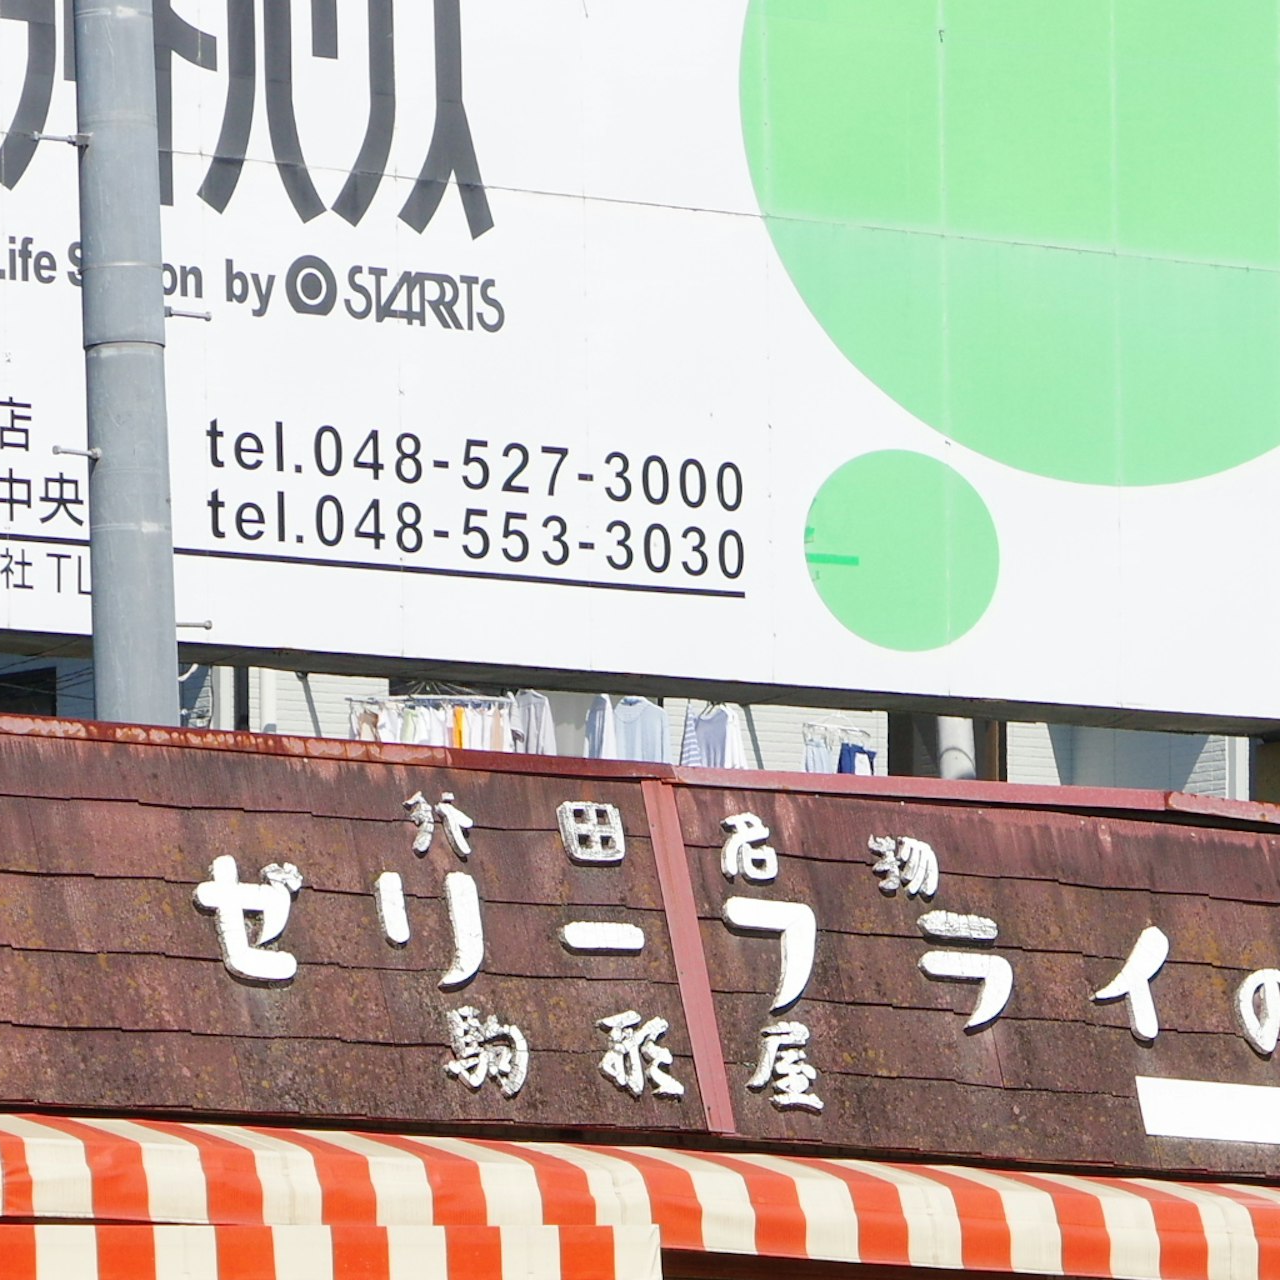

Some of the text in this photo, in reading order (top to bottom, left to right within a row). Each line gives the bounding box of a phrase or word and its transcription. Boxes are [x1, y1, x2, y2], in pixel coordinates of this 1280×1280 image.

[225, 259, 276, 317] by
[206, 418, 744, 512] tel.048-527-3000
[207, 488, 745, 579] tel.048-553-3030
